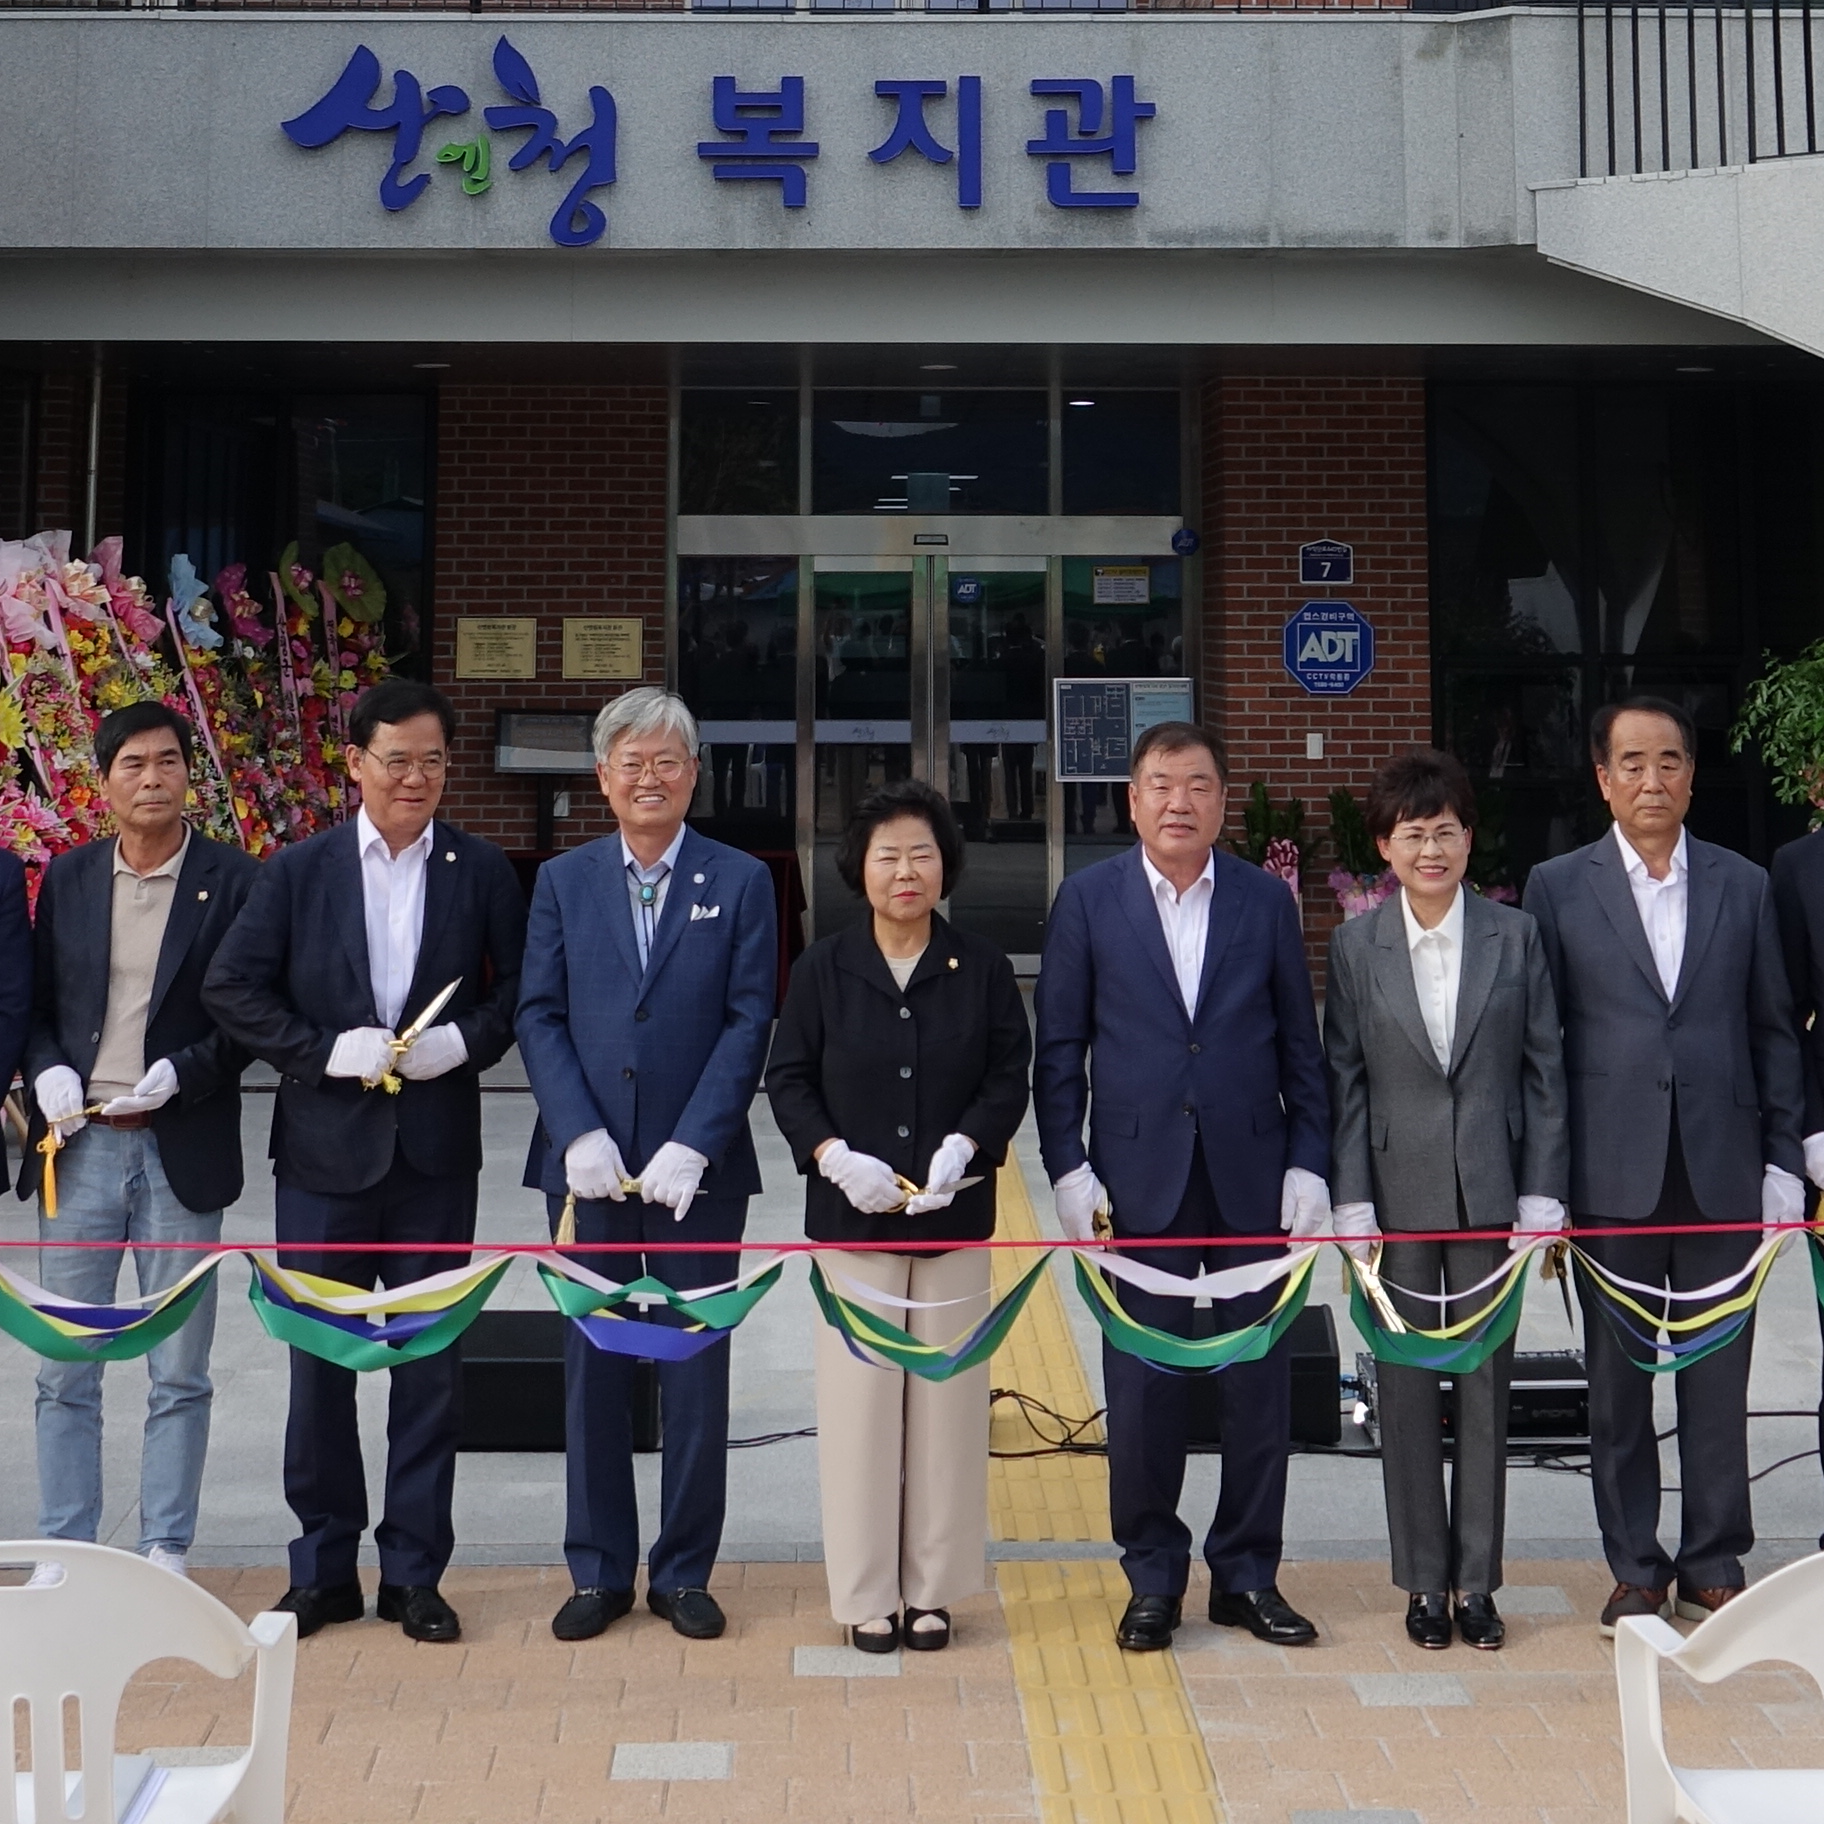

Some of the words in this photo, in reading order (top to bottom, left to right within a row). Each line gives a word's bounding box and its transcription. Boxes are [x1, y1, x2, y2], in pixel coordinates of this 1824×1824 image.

[281, 34, 617, 247] 산엔청
[698, 74, 1157, 209] 복지관
[1321, 561, 1331, 578] 7
[1299, 631, 1359, 663] ADT
